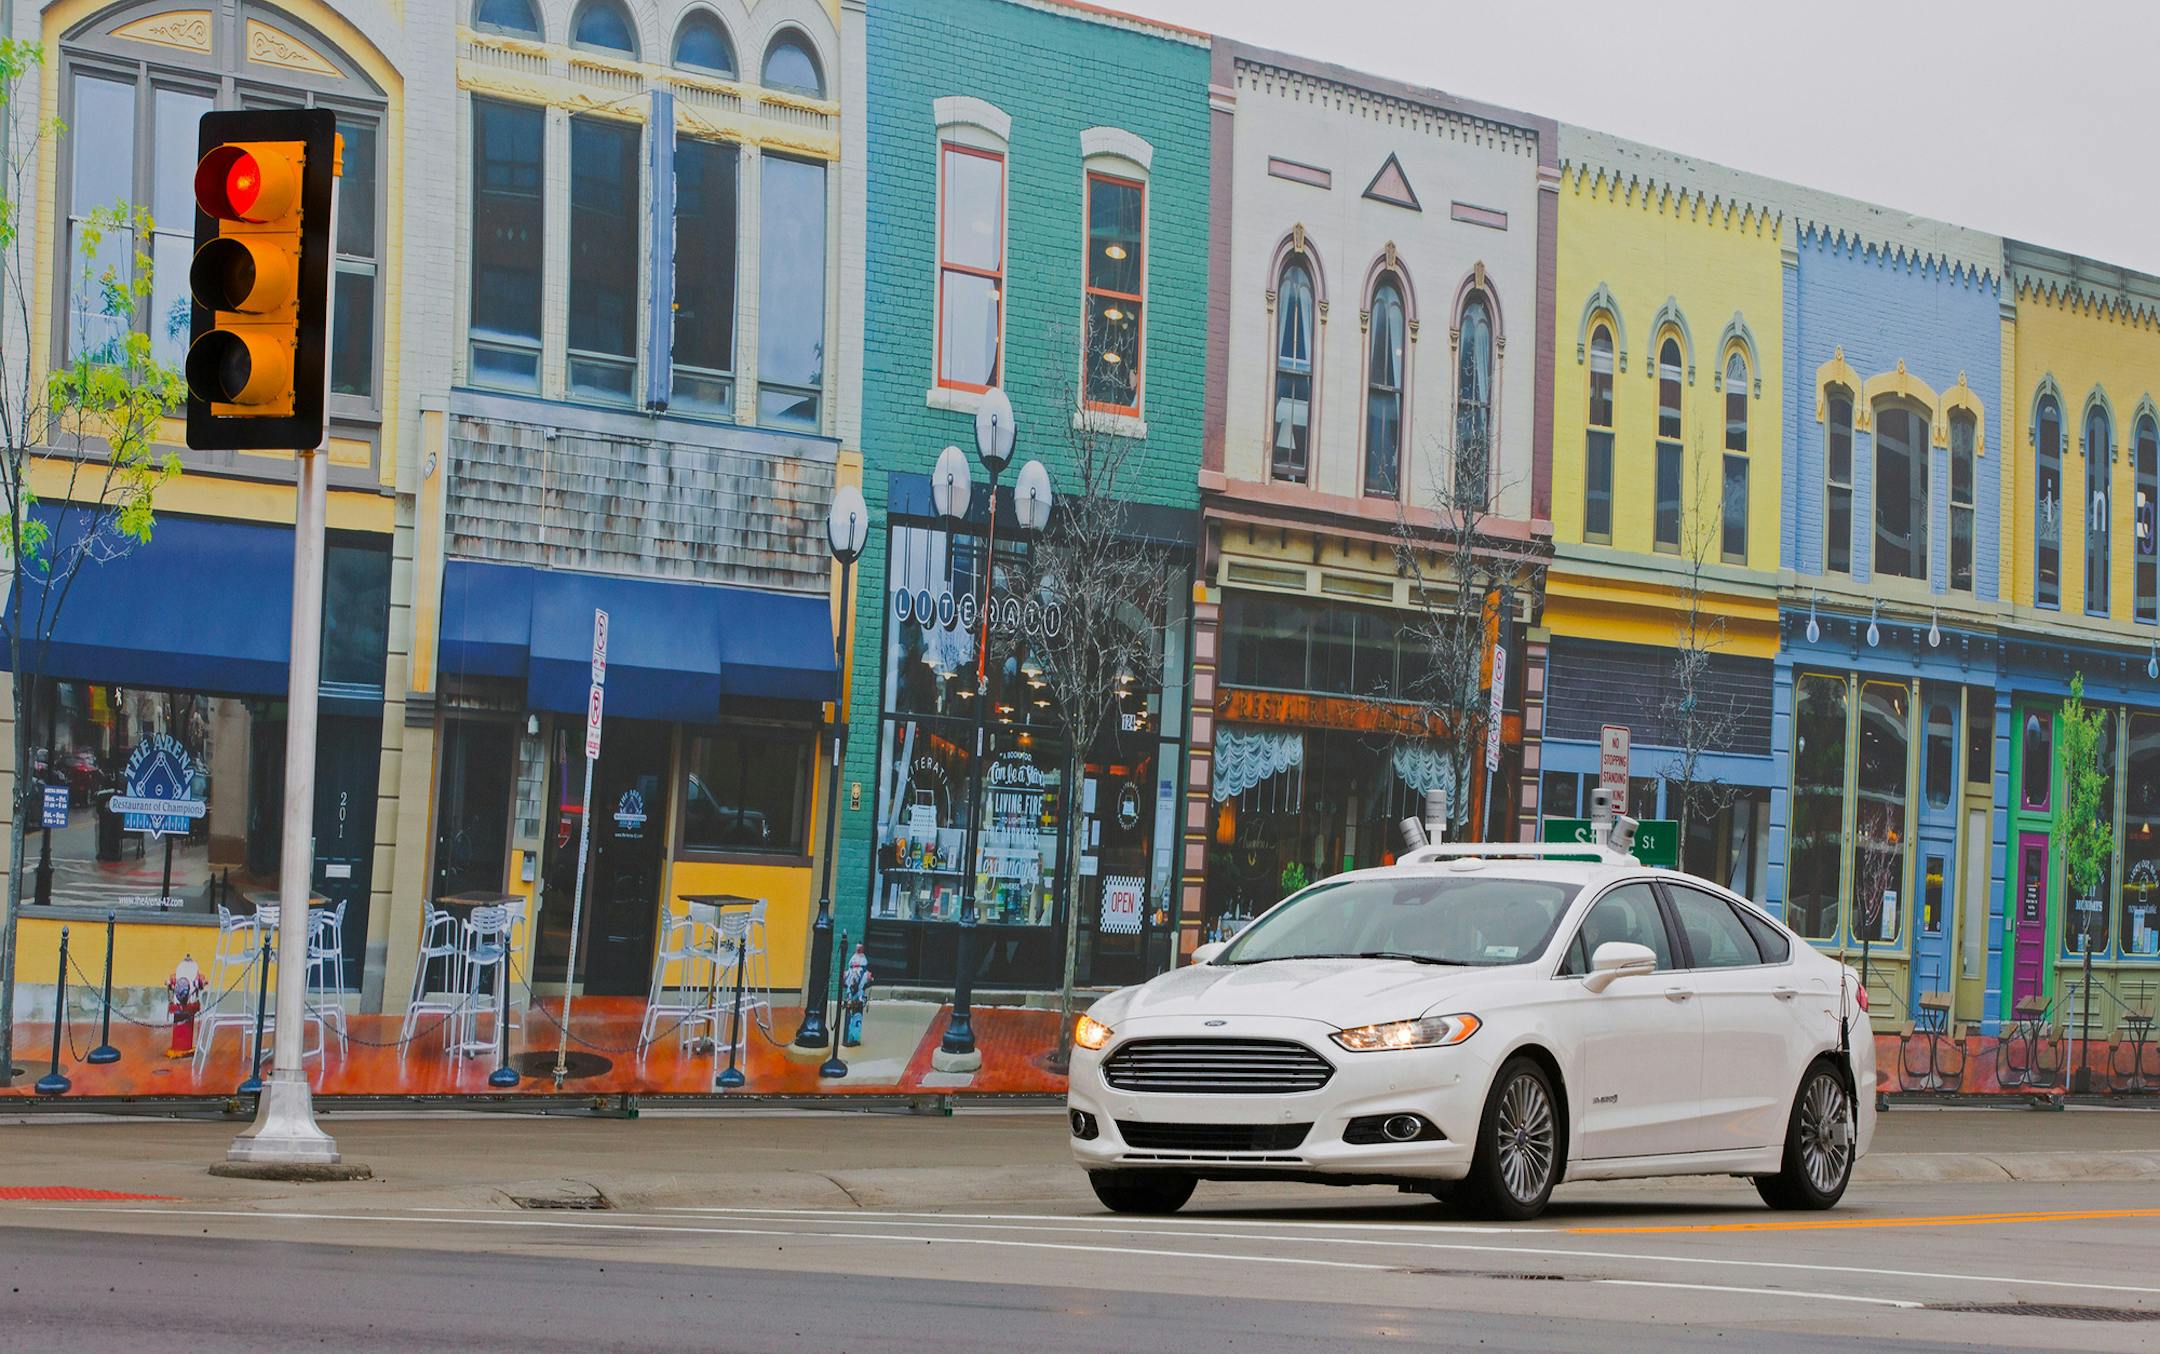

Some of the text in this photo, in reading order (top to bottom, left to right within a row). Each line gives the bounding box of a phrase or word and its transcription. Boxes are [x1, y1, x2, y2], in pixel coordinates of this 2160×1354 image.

[1612, 737, 1619, 749] NO
[124, 733, 195, 786] THE ARENA
[1603, 754, 1627, 767] STOPPING
[1603, 771, 1626, 785] STANDING
[1612, 790, 1624, 802] KING
[112, 798, 204, 815] Restaurant of Champions
[995, 793, 1022, 814] LIVING
[1024, 795, 1043, 816] FIRE
[338, 791, 349, 839] 201
[1642, 835, 1655, 849] St
[1111, 891, 1134, 913] OPEN
